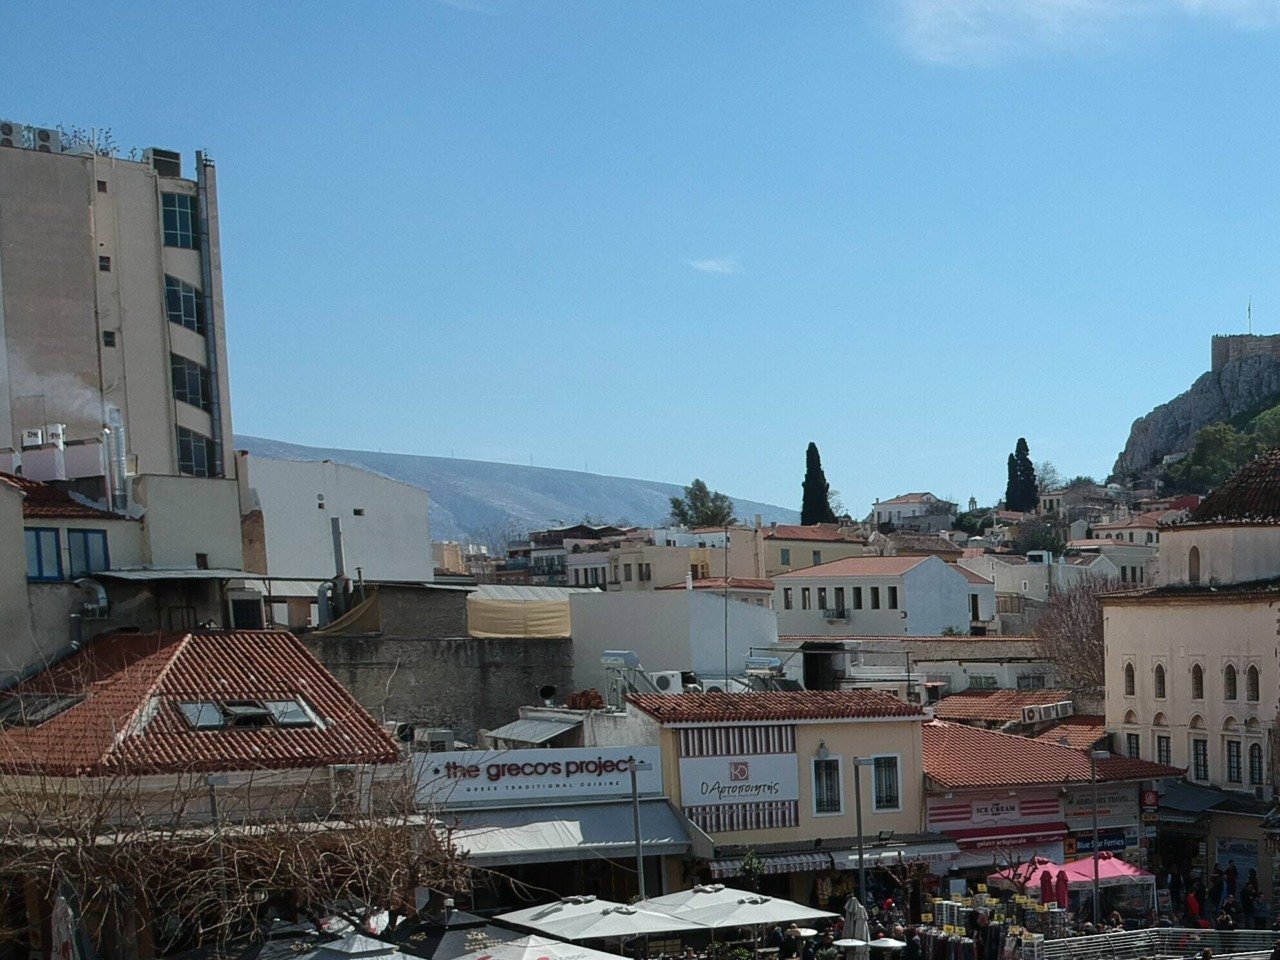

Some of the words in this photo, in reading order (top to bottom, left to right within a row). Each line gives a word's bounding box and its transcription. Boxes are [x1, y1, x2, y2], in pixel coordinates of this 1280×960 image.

[444, 760, 481, 779] the
[486, 759, 562, 782] greco's
[505, 782, 573, 791] TRADITIONAL
[991, 805, 1016, 813] CREAM
[976, 840, 996, 848] gelato
[1077, 841, 1090, 849] Blue
[1090, 840, 1104, 848] Sar
[1104, 838, 1125, 847] Ferries
